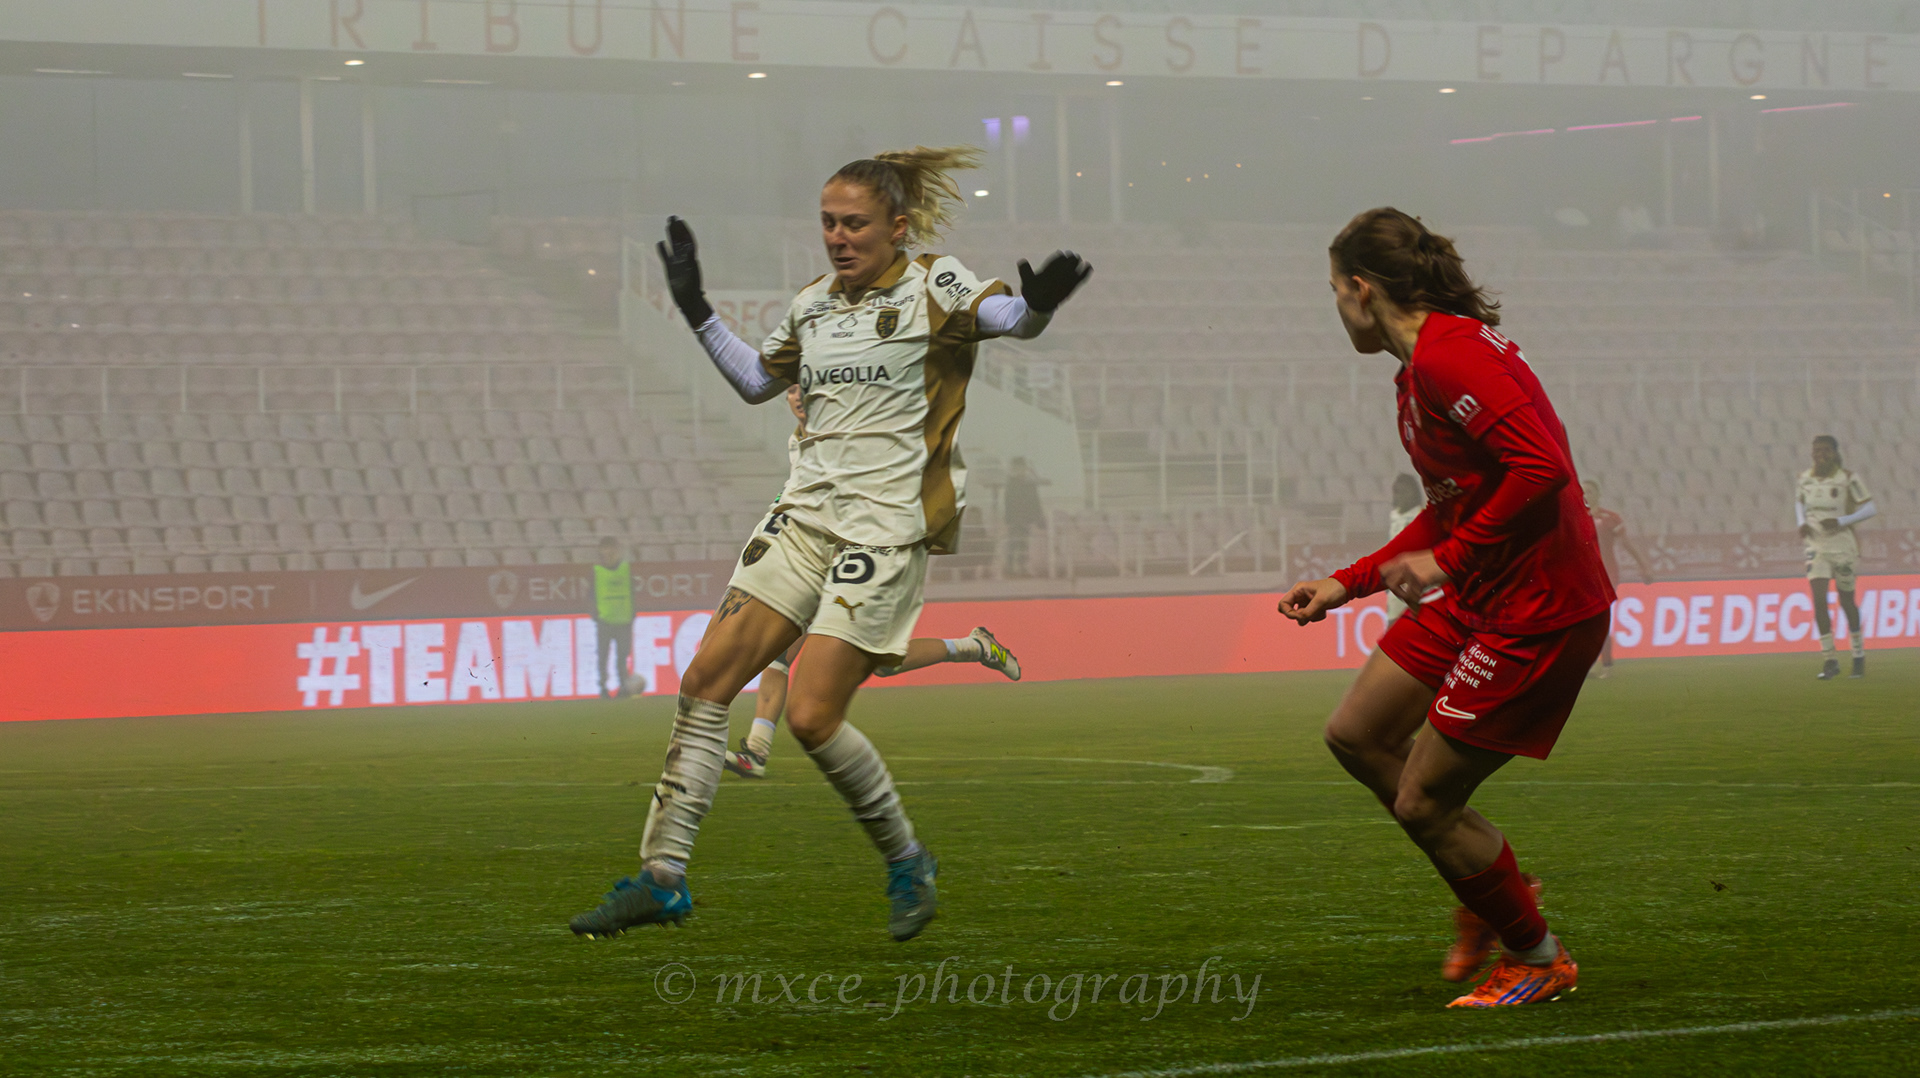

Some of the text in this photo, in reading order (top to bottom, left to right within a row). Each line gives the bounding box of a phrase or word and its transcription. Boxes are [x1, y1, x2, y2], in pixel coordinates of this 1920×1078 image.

[866, 5, 1264, 75] CAISSE
[1356, 21, 1392, 79] D
[1475, 25, 1890, 88] EPARGNE
[816, 364, 891, 386] VEOLIA
[528, 573, 714, 602] EKINPORT
[1651, 595, 1714, 646] DE
[1719, 588, 1920, 644] DECMBR
